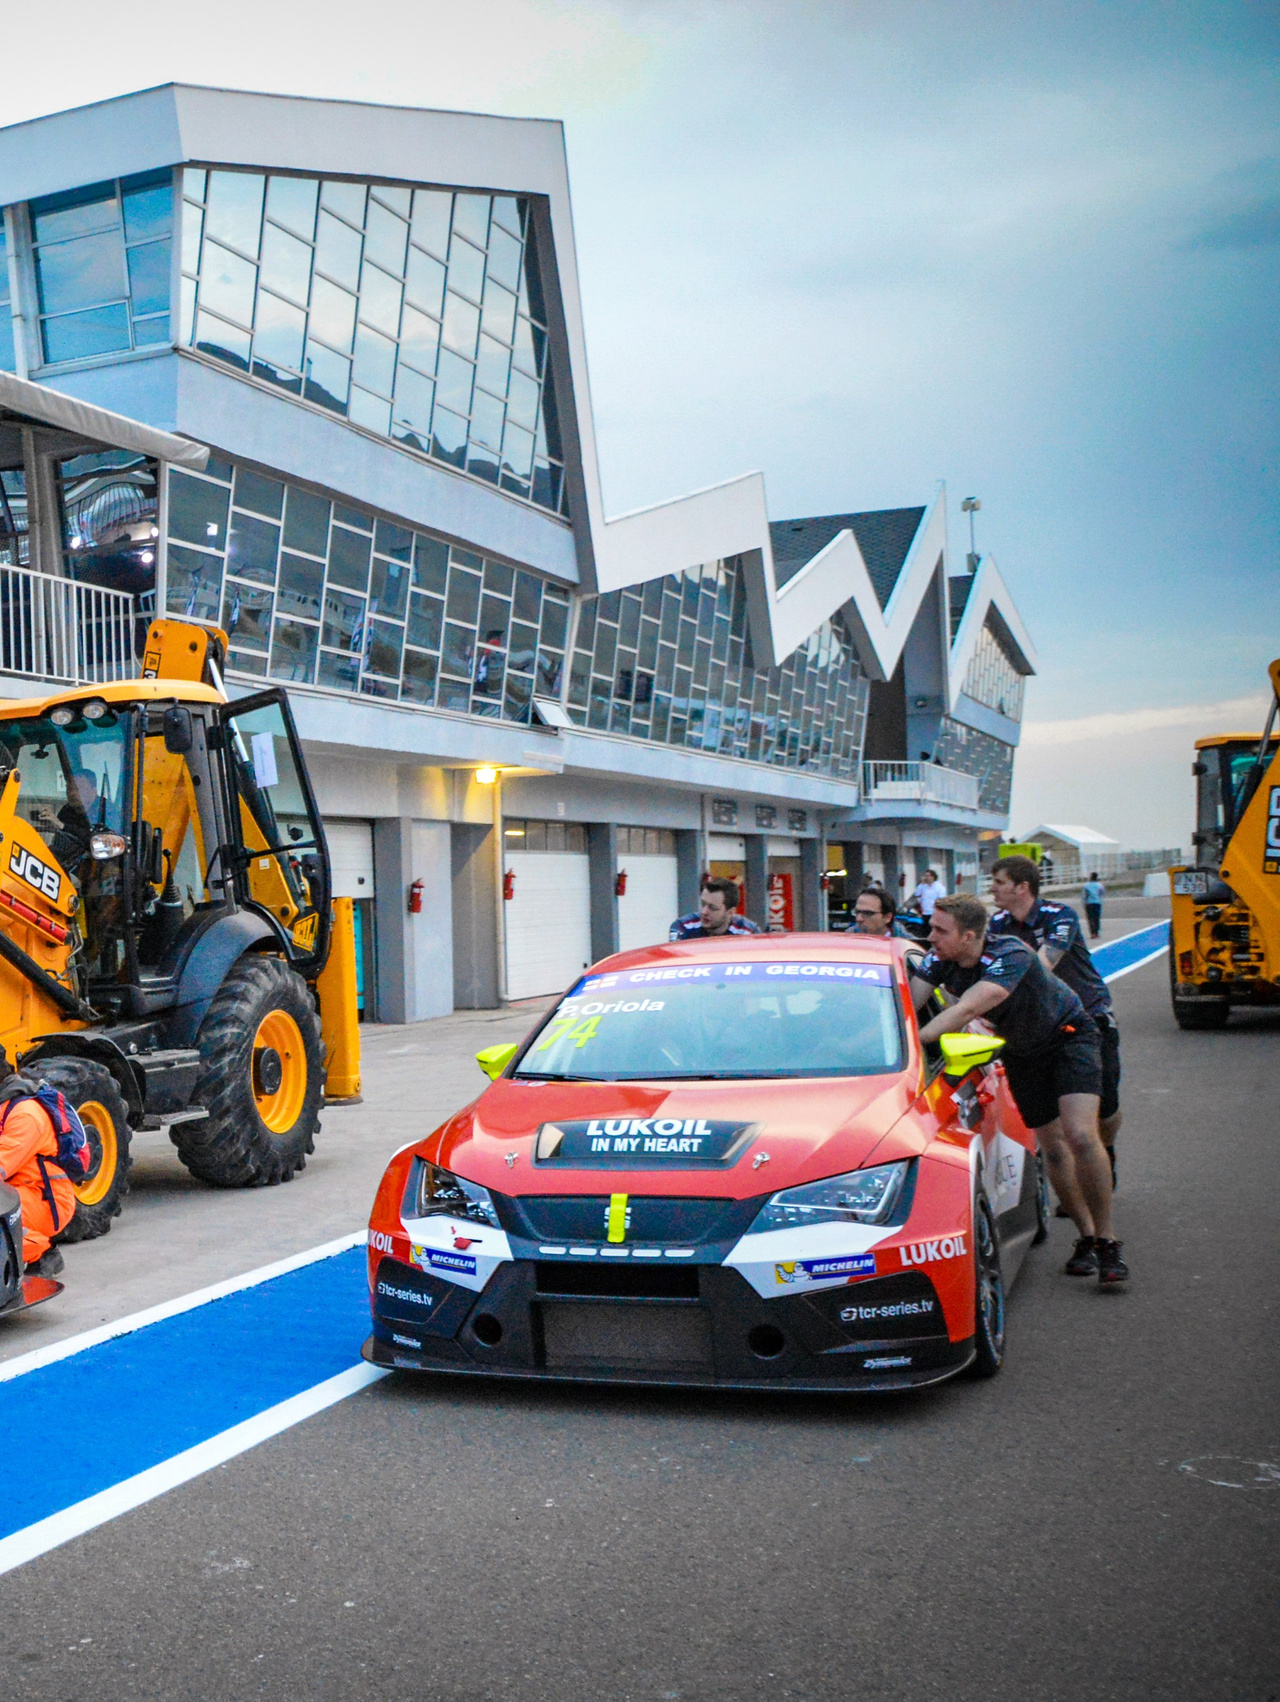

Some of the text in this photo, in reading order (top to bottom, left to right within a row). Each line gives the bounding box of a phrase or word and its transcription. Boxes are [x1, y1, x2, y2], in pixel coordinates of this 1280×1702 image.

[10, 849, 60, 900] JCB
[629, 965, 880, 983] CHECK IN GEORGIA
[537, 1015, 602, 1051] 74
[586, 1119, 712, 1136] LUKOIL
[590, 1138, 702, 1152] IN MY HEART
[368, 1229, 394, 1255] KOIL
[899, 1236, 967, 1267] LUKOIL
[431, 1253, 476, 1269] MICHELIN
[812, 1259, 874, 1273] MICHELIN
[385, 1282, 433, 1306] tcr-series.tv
[858, 1300, 934, 1320] tcr-series.tv
